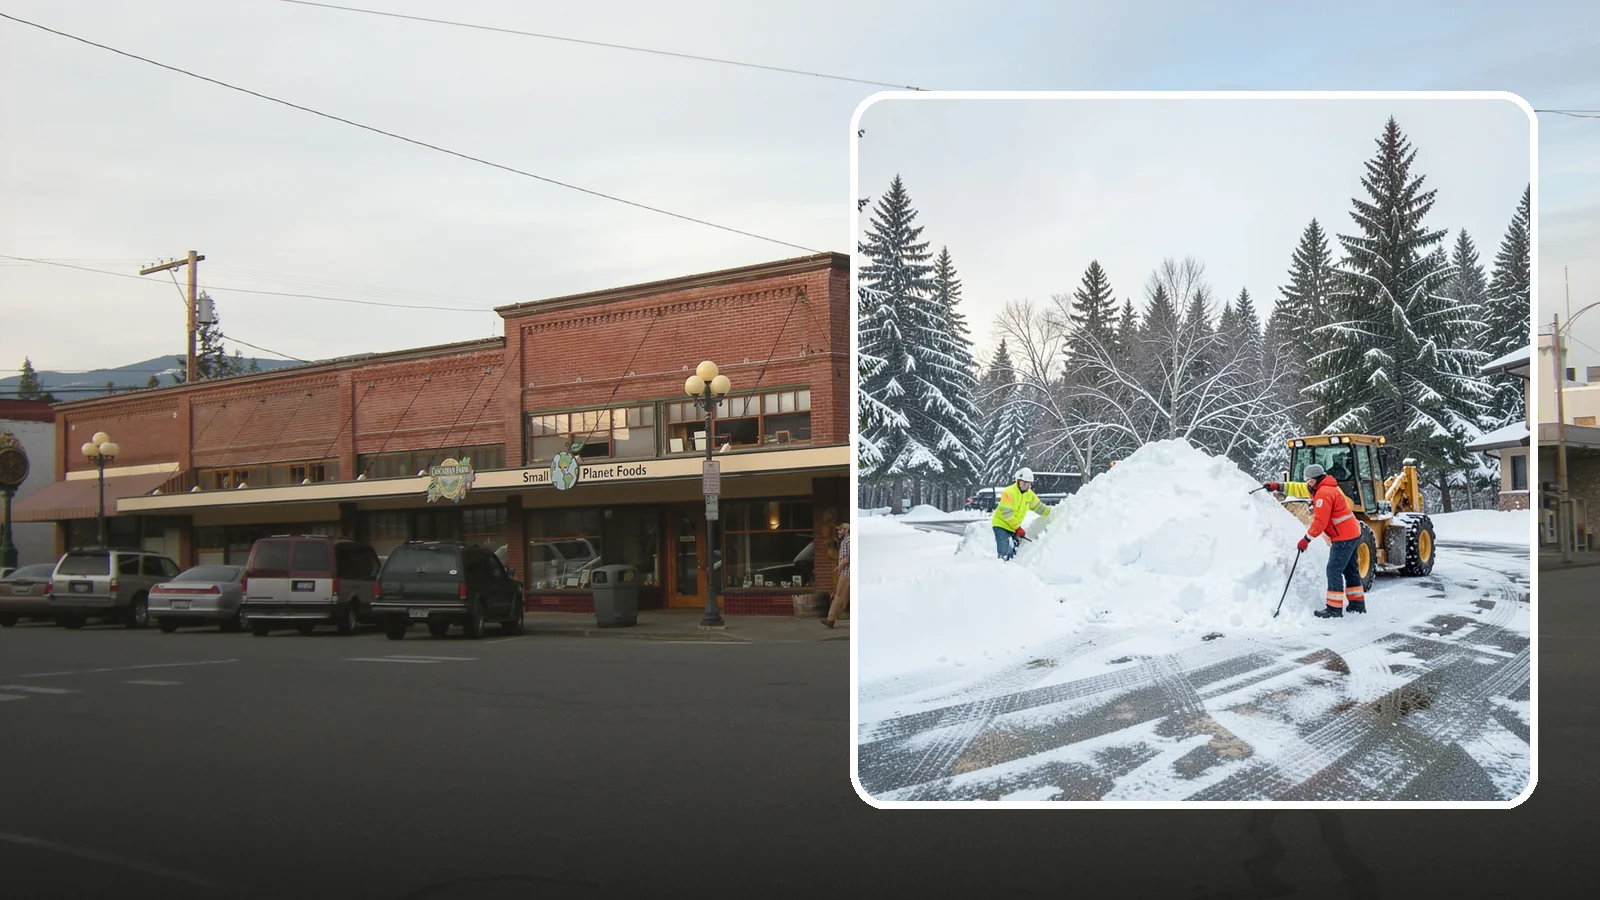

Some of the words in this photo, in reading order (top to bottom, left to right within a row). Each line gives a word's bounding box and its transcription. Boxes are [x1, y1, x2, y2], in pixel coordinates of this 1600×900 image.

[523, 471, 549, 483] Small
[583, 467, 614, 479] Planet
[617, 464, 647, 477] Foods
